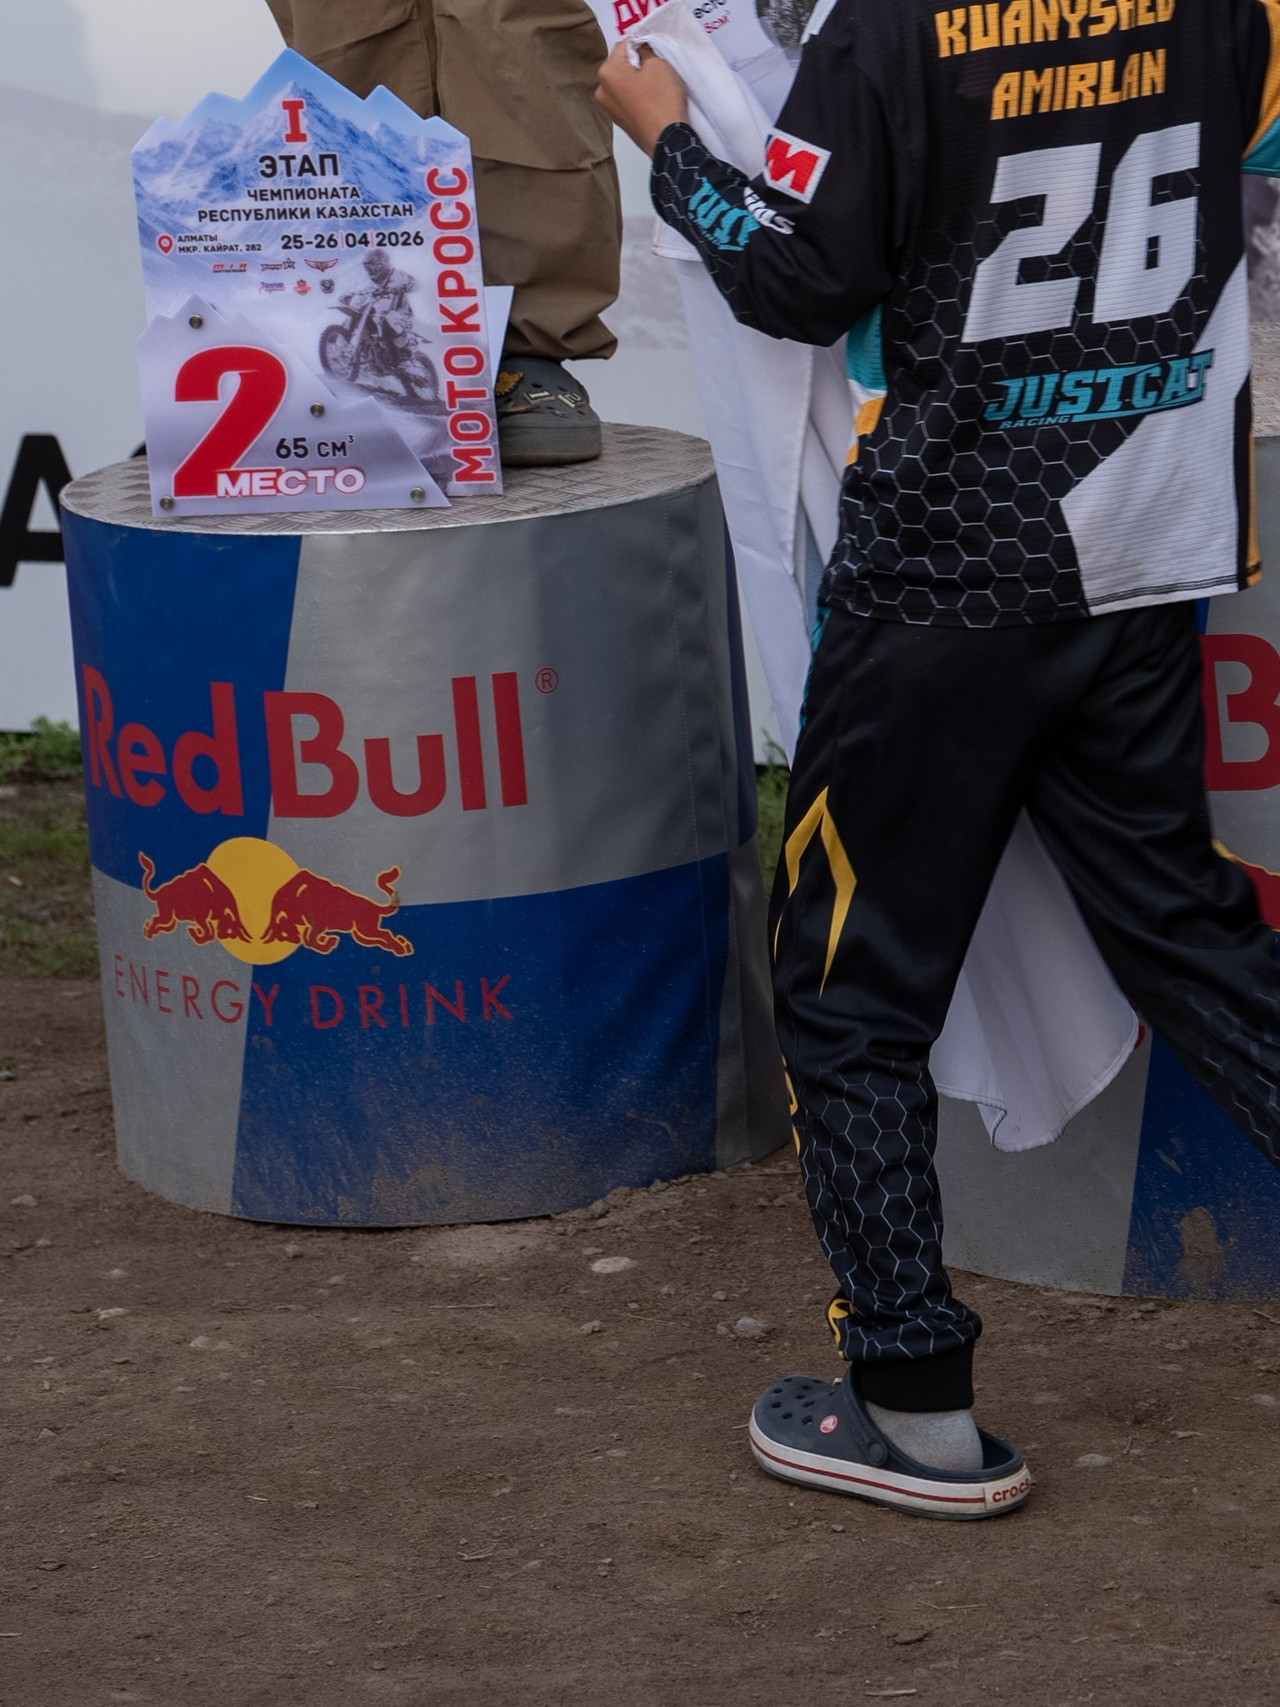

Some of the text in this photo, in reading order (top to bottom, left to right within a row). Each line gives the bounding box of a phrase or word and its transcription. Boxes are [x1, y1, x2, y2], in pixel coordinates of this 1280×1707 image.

[990, 48, 1167, 121] AMIRLAN
[281, 98, 308, 143] I
[258, 153, 341, 179] ЭТАП
[246, 186, 362, 203] ЧЕМПИОНАТА
[197, 203, 414, 224] РЕСПУБЛИКИ КАЗАХСТАН
[176, 233, 219, 244] АЛМАТЫ
[280, 230, 425, 251] 25-26 04 2026
[962, 122, 1201, 344] 26
[178, 243, 263, 255] МКР. КАЙРАТ, 282
[426, 166, 497, 485] МОТО КРОСС
[173, 345, 288, 498] 2
[999, 414, 1071, 430] RACING
[275, 437, 310, 459] 65
[215, 467, 366, 497] МЕСТО
[81, 661, 247, 817] Red
[262, 670, 529, 820] Bull
[113, 952, 516, 1032] ENERGY DRINK
